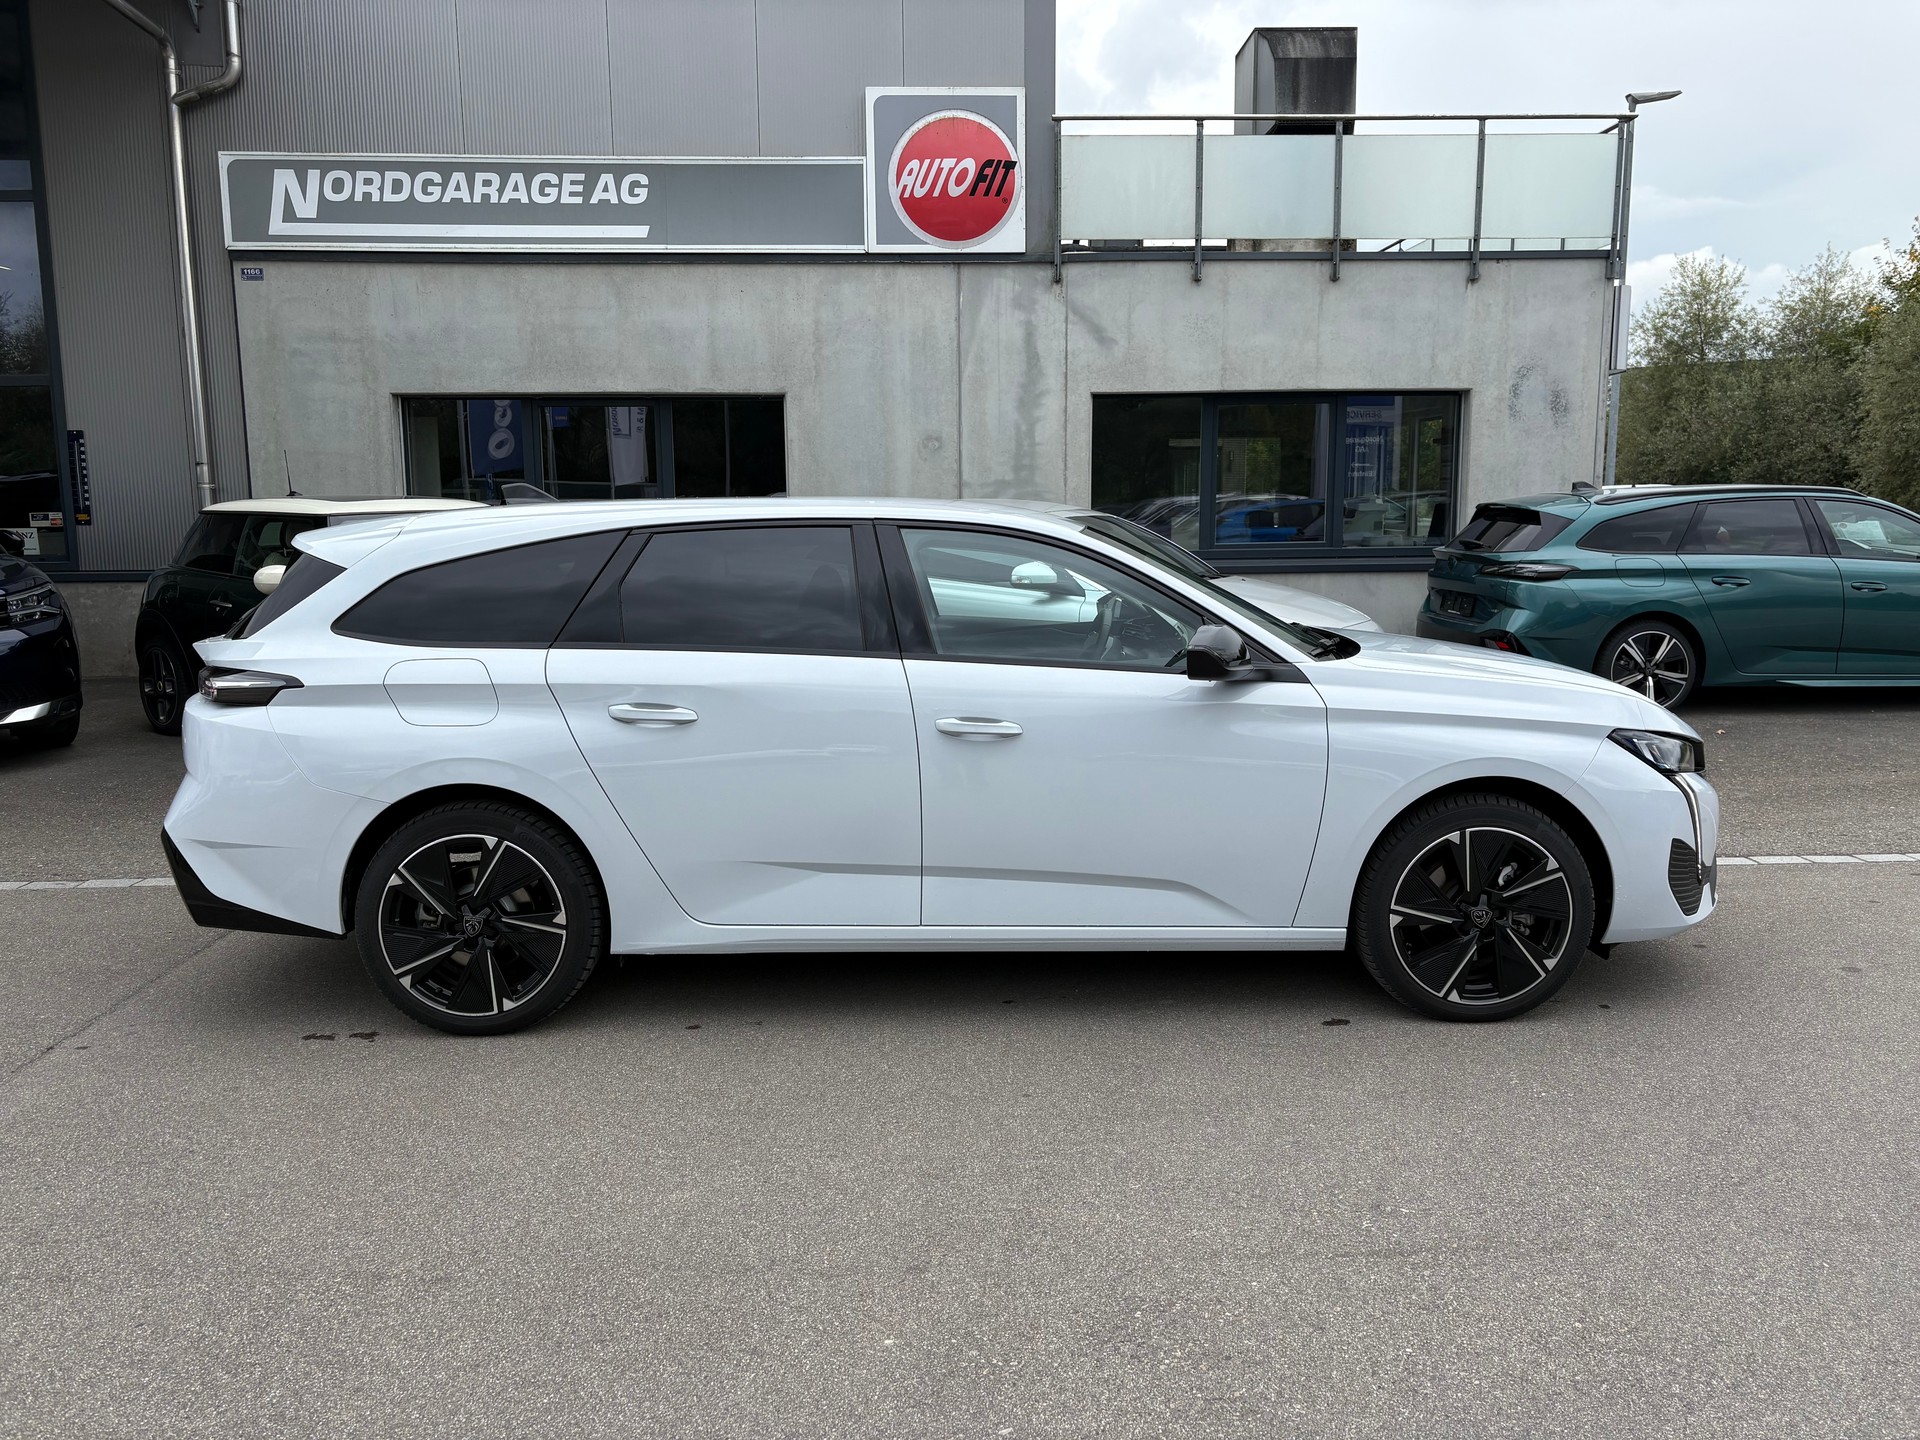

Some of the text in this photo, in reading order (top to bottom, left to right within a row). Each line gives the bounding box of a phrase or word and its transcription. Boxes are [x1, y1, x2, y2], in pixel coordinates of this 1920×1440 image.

[270, 168, 650, 219] NORDGARAGE AG
[897, 157, 1018, 199] AUTOFIT
